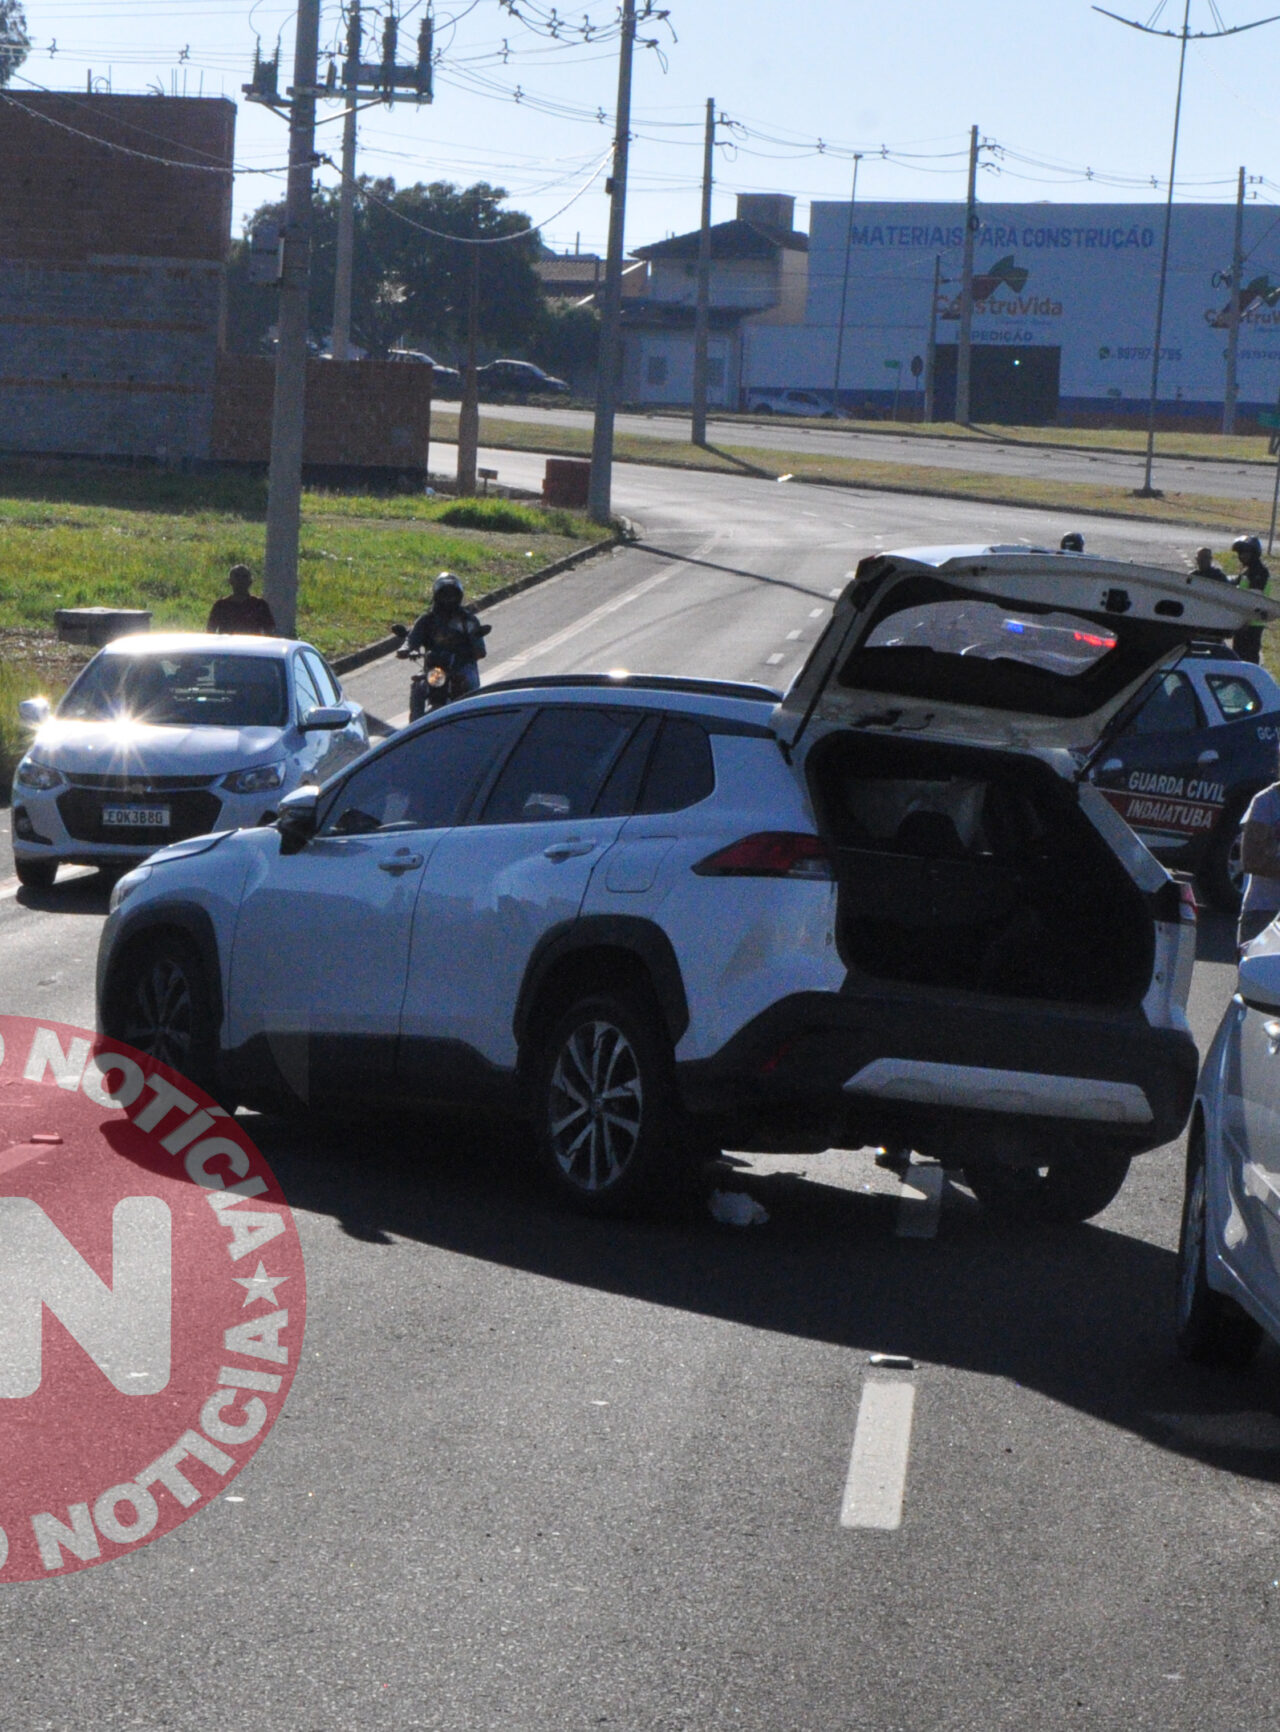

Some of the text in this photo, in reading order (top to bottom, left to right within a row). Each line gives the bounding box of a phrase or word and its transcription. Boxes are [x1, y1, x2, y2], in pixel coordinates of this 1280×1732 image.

[852, 224, 1154, 249] MATERIAIS ARA CONSTRUÇÃO
[933, 294, 1063, 316] CostruVida
[1128, 771, 1226, 802] GUARDA CIVIL
[1126, 799, 1213, 829] INDAIATUBA
